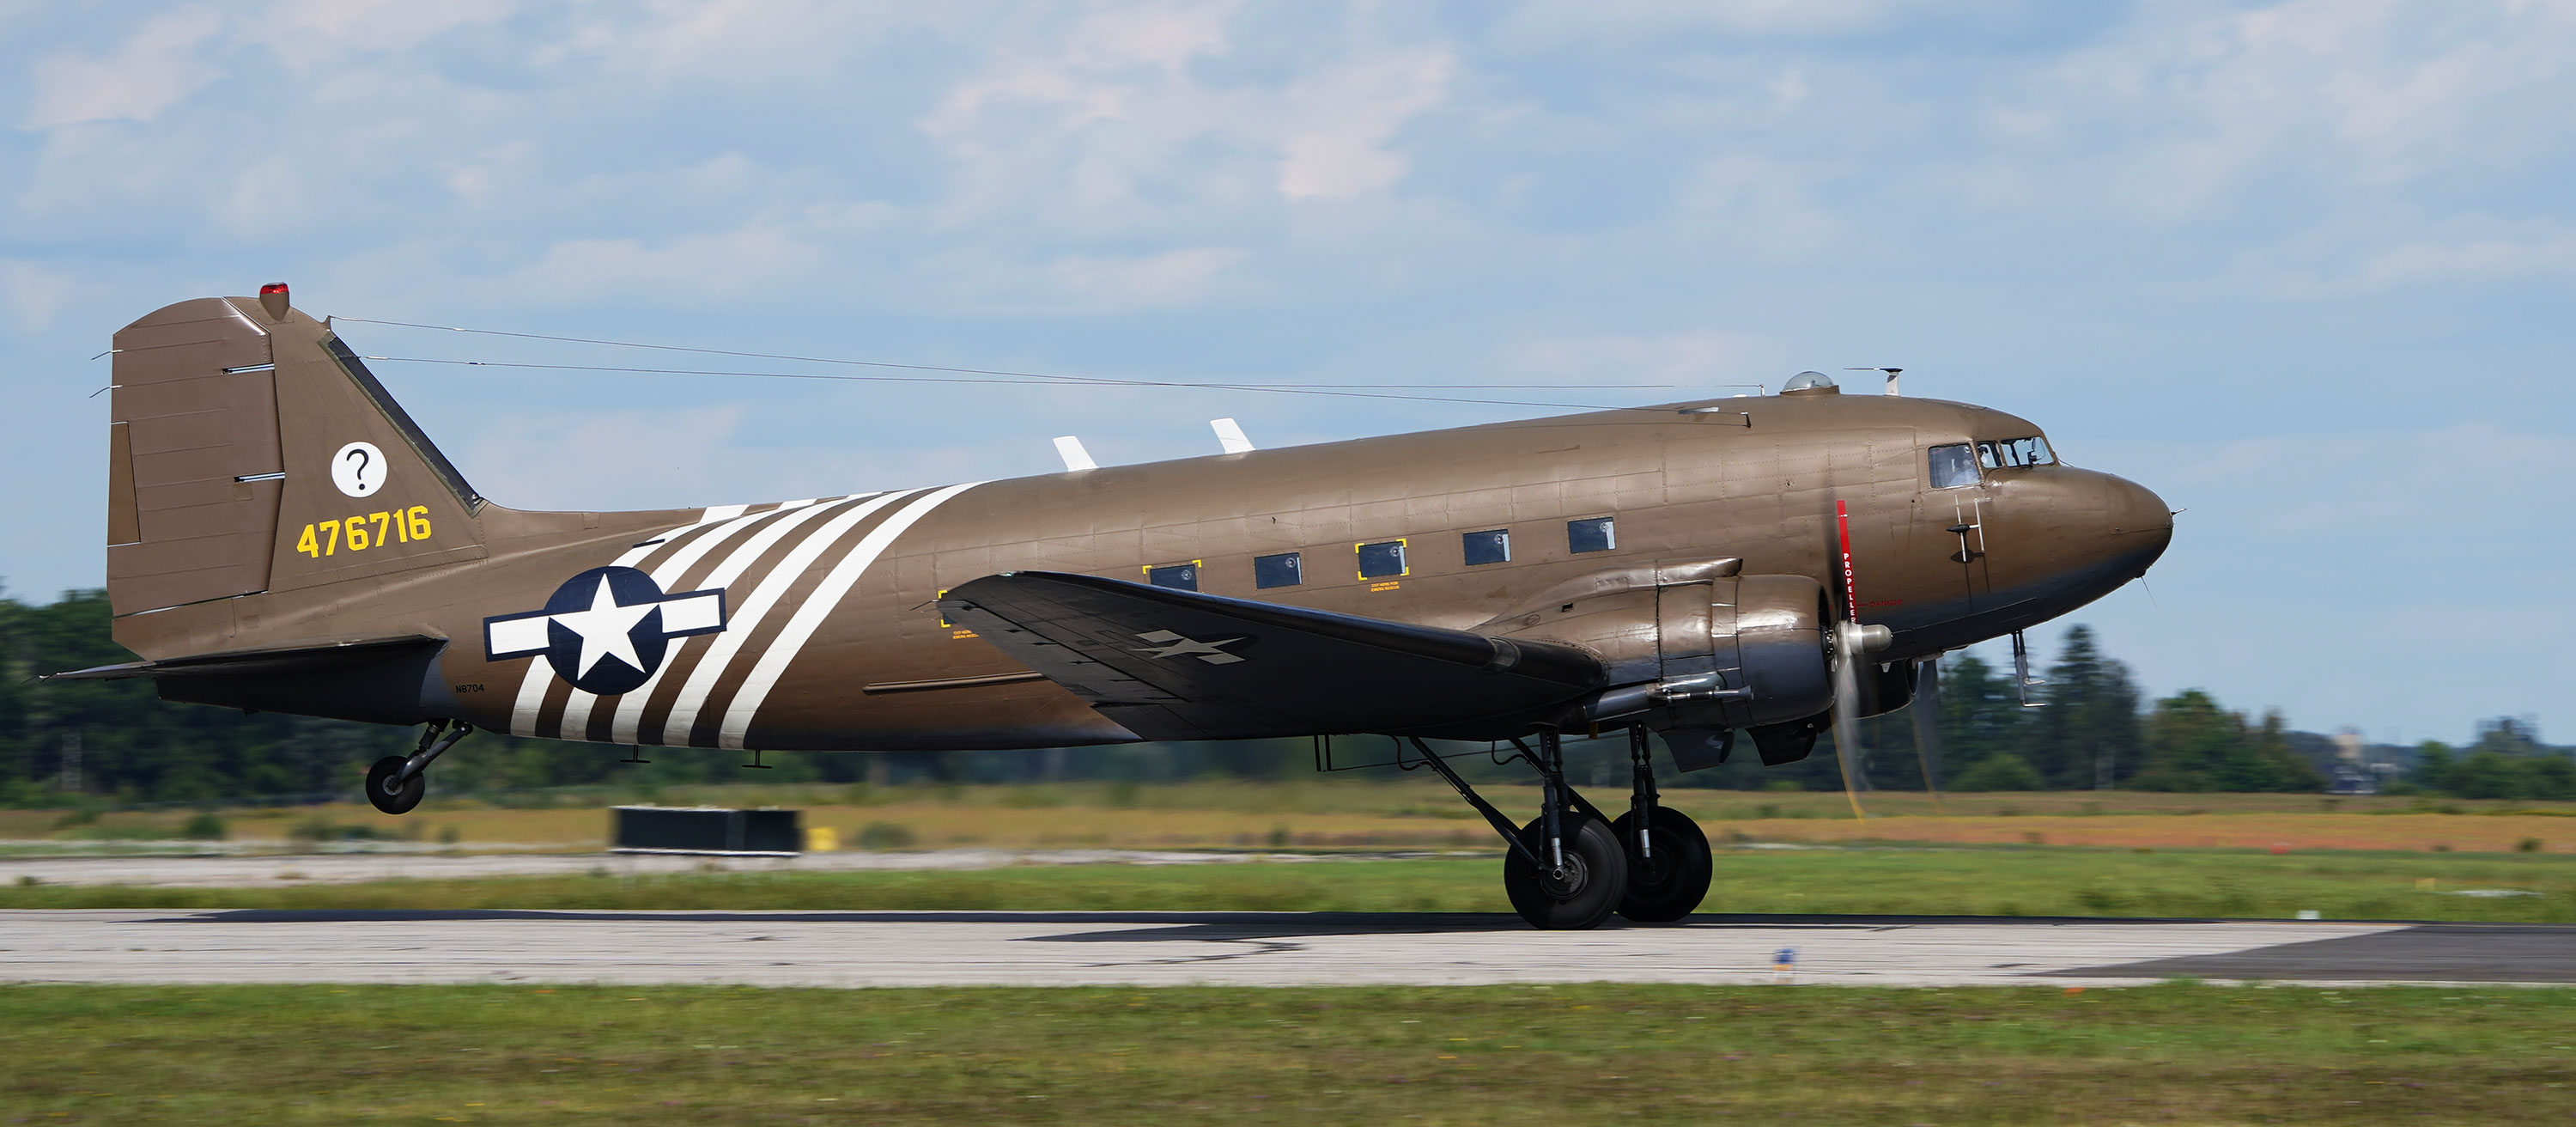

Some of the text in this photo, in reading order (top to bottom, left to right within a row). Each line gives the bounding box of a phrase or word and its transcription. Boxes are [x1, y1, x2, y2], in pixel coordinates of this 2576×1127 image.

[346, 448, 369, 490] ?
[296, 505, 432, 558] 476716
[1844, 552, 1856, 624] PROPELLER
[1869, 599, 1903, 608] DANGER
[455, 684, 484, 693] N8704
